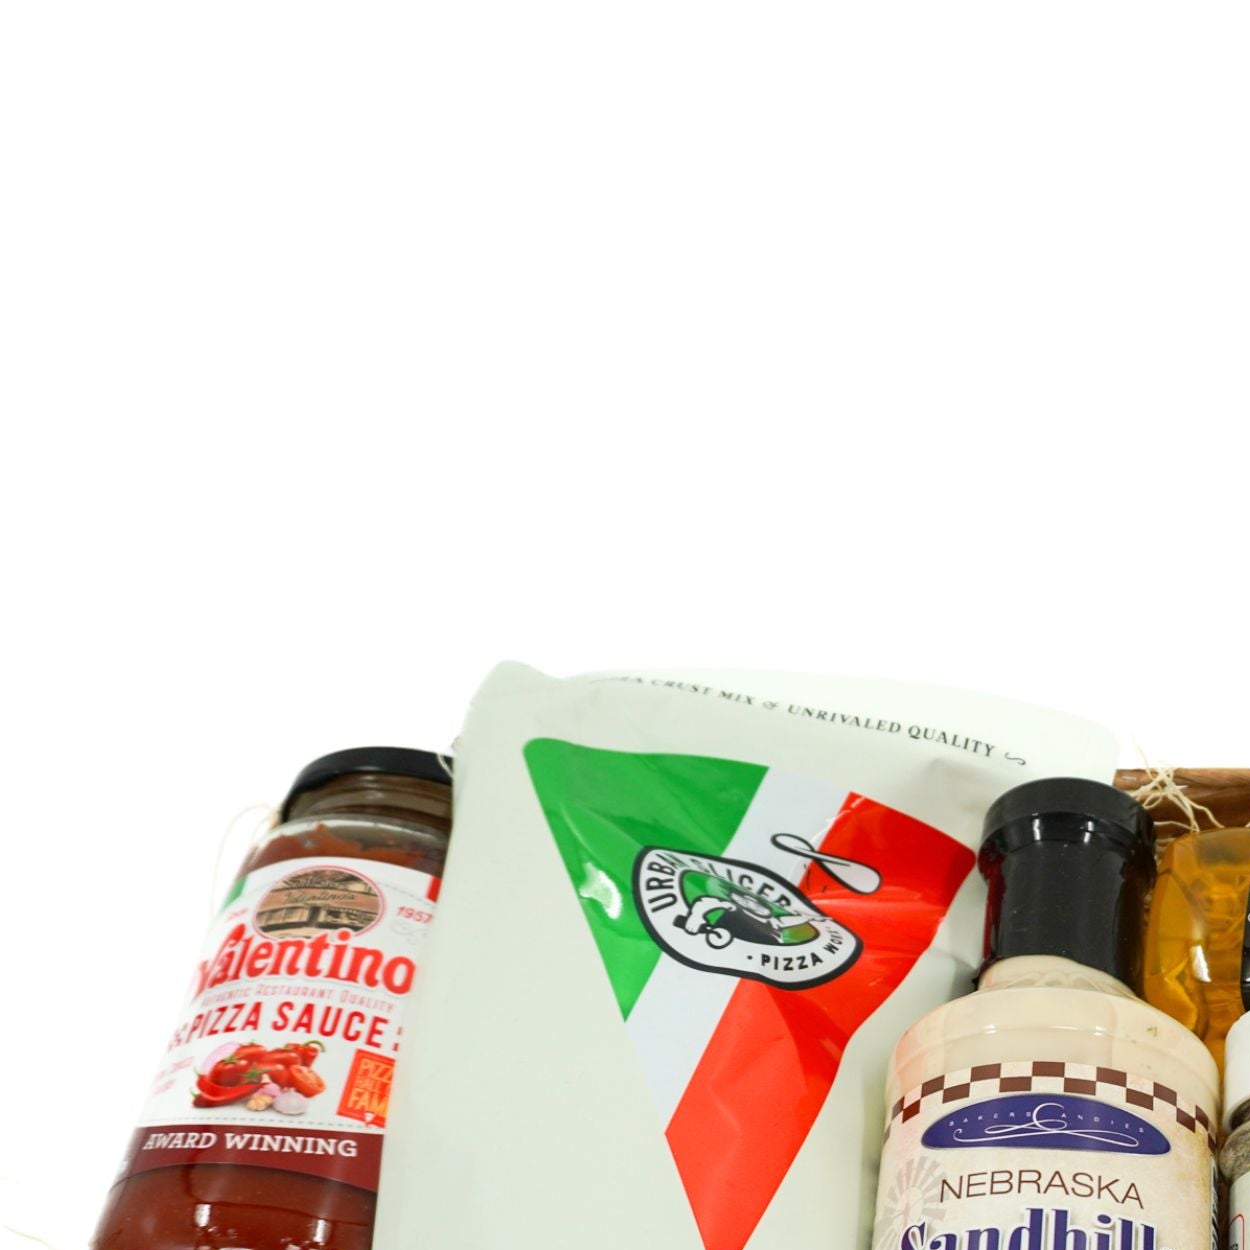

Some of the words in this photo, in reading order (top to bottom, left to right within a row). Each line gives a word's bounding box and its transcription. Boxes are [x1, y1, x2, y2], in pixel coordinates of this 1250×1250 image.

[651, 678, 712, 696] CRUST
[719, 690, 755, 705] MIX
[787, 704, 902, 734] UNRIVALED
[907, 724, 995, 758] QUALITY
[645, 852, 684, 913] URBAN
[690, 858, 793, 908] SLICER
[395, 906, 433, 924] 1957
[760, 952, 824, 972] PIZZA
[255, 983, 334, 1001] RESTAURANT
[339, 990, 394, 1014] QUALITY
[186, 1001, 263, 1042] PIZZA
[271, 1001, 389, 1049] SAUCE
[948, 1111, 1033, 1128] BAKERS
[142, 1132, 217, 1151] AWARD
[225, 1133, 359, 1158] WINNING
[939, 1169, 1145, 1210] NEBRASKA
